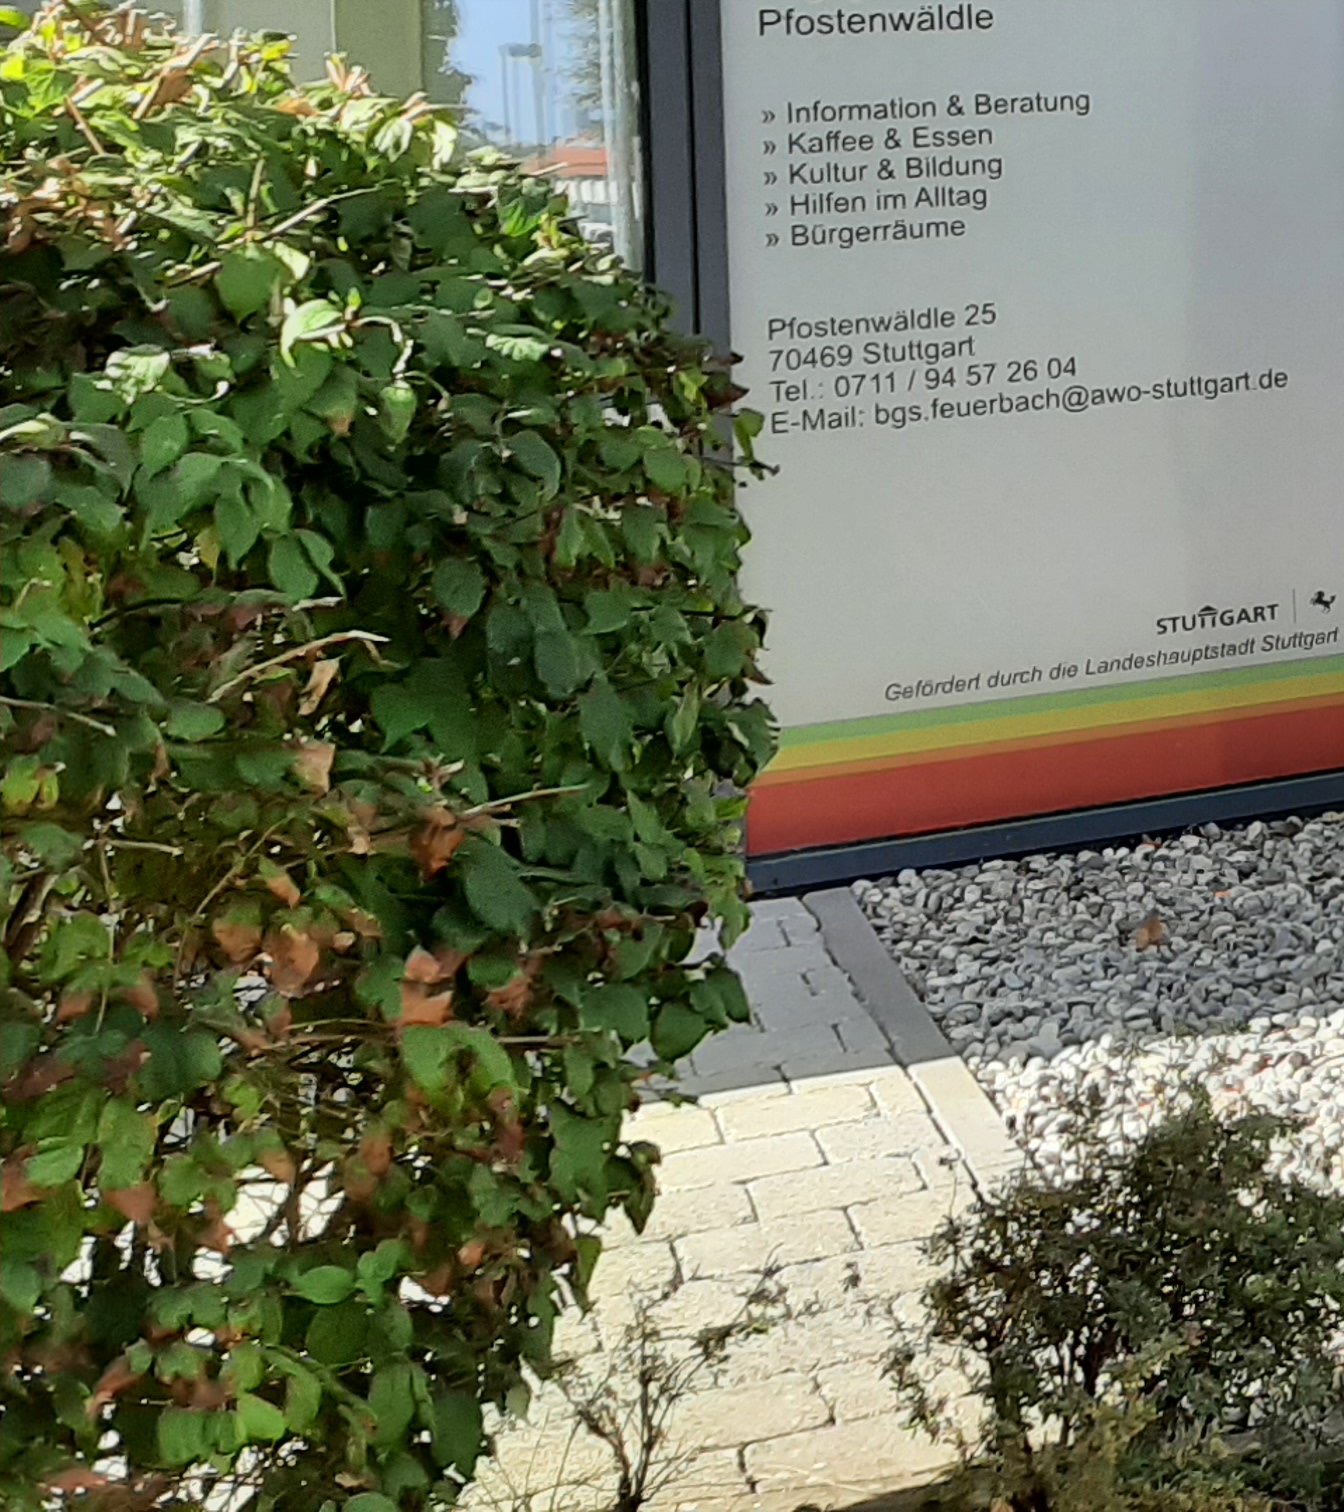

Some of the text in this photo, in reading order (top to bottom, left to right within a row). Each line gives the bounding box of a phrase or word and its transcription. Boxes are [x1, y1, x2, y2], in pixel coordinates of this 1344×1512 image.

[758, 2, 994, 37] Pfostenwäldle
[787, 91, 1091, 125] Information & Beratung
[787, 125, 993, 155] Kaffee & Essen
[788, 154, 1003, 185] Kultur & Bildung
[790, 185, 988, 217] Hilfen im Alltag
[790, 218, 966, 250] Bürgerräume
[767, 302, 997, 342] Pfostenwäldle 25
[768, 334, 976, 373] 70469 Stuttgart
[768, 378, 824, 403] Tel.:
[833, 370, 895, 398] 0711
[924, 366, 957, 391] 94
[965, 362, 998, 387] 57
[1006, 359, 1039, 384] 26
[1046, 356, 1077, 380] 04
[770, 367, 1289, 435] E-Mail: bgs.feuerbach@awo-stuttgart.de
[1155, 603, 1280, 636] STUTTGART
[884, 626, 1340, 702] Gefördert durch die Landeshauptstadt Stuttgart
